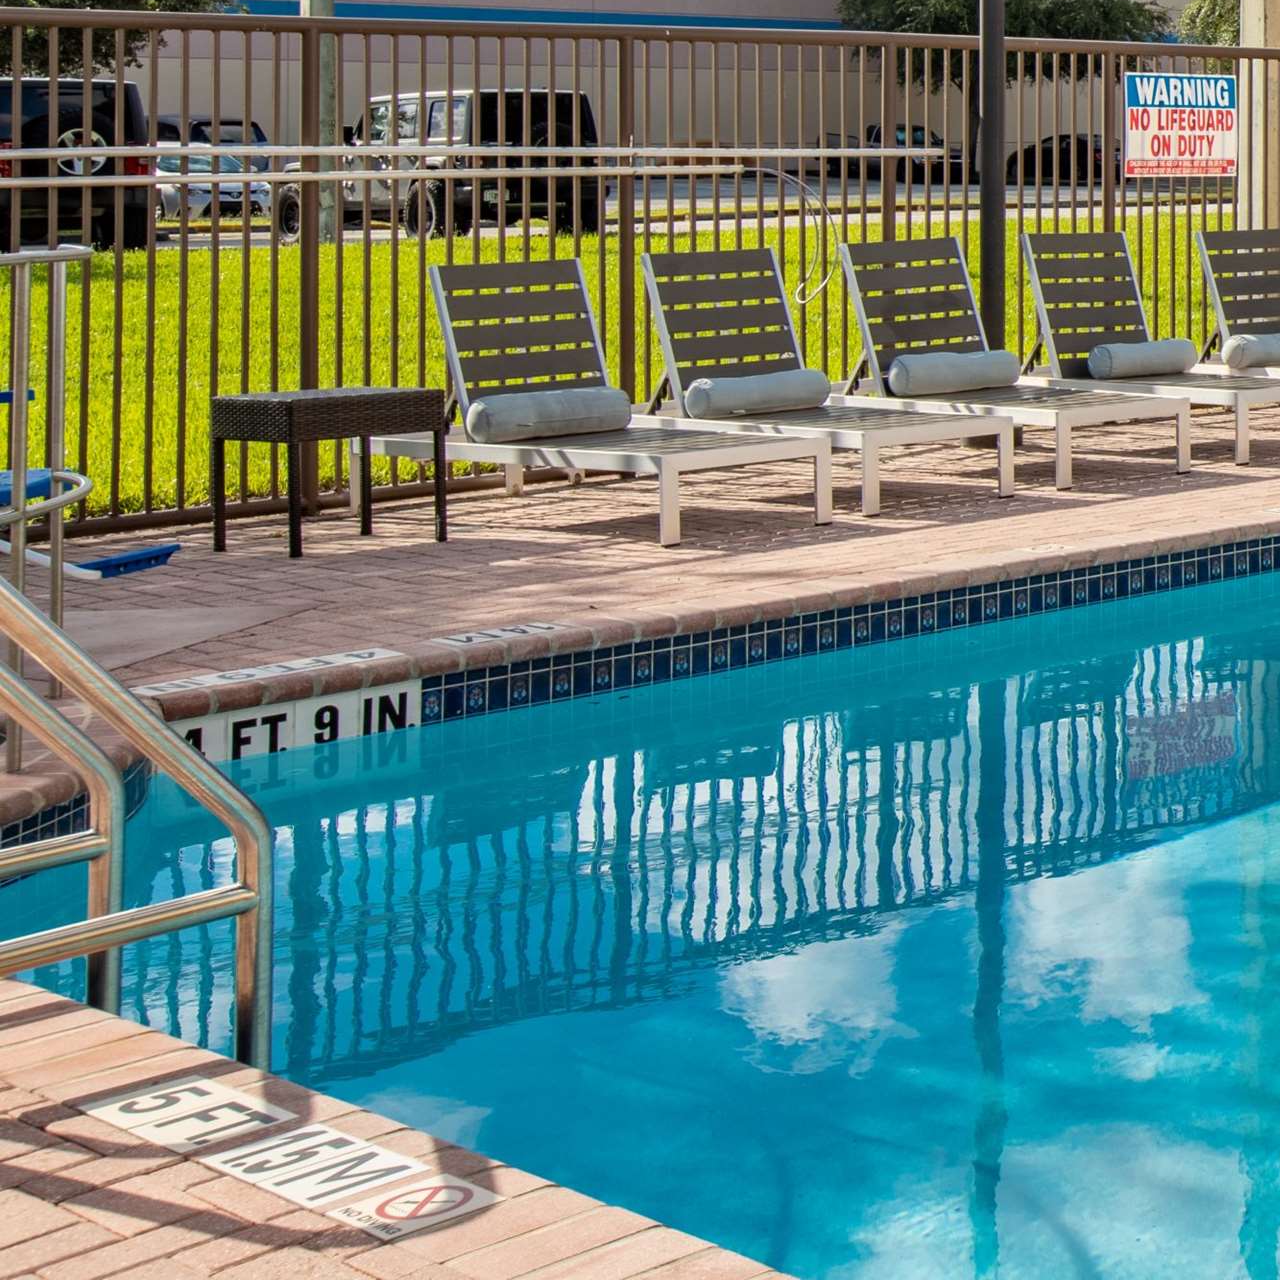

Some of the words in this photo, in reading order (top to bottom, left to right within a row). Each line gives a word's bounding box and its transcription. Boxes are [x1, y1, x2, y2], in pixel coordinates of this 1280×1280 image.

[1135, 77, 1230, 106] WARNING
[1129, 108, 1150, 131] NO
[1157, 108, 1234, 131] LIFEGUARD
[1150, 134, 1171, 157] ON
[1177, 135, 1215, 157] DUTY
[232, 713, 289, 760] FT.
[314, 704, 340, 744] 9
[362, 692, 416, 736] IN.
[118, 1085, 211, 1115] 5
[338, 1207, 363, 1218] NO
[356, 1214, 402, 1236] DIVING
